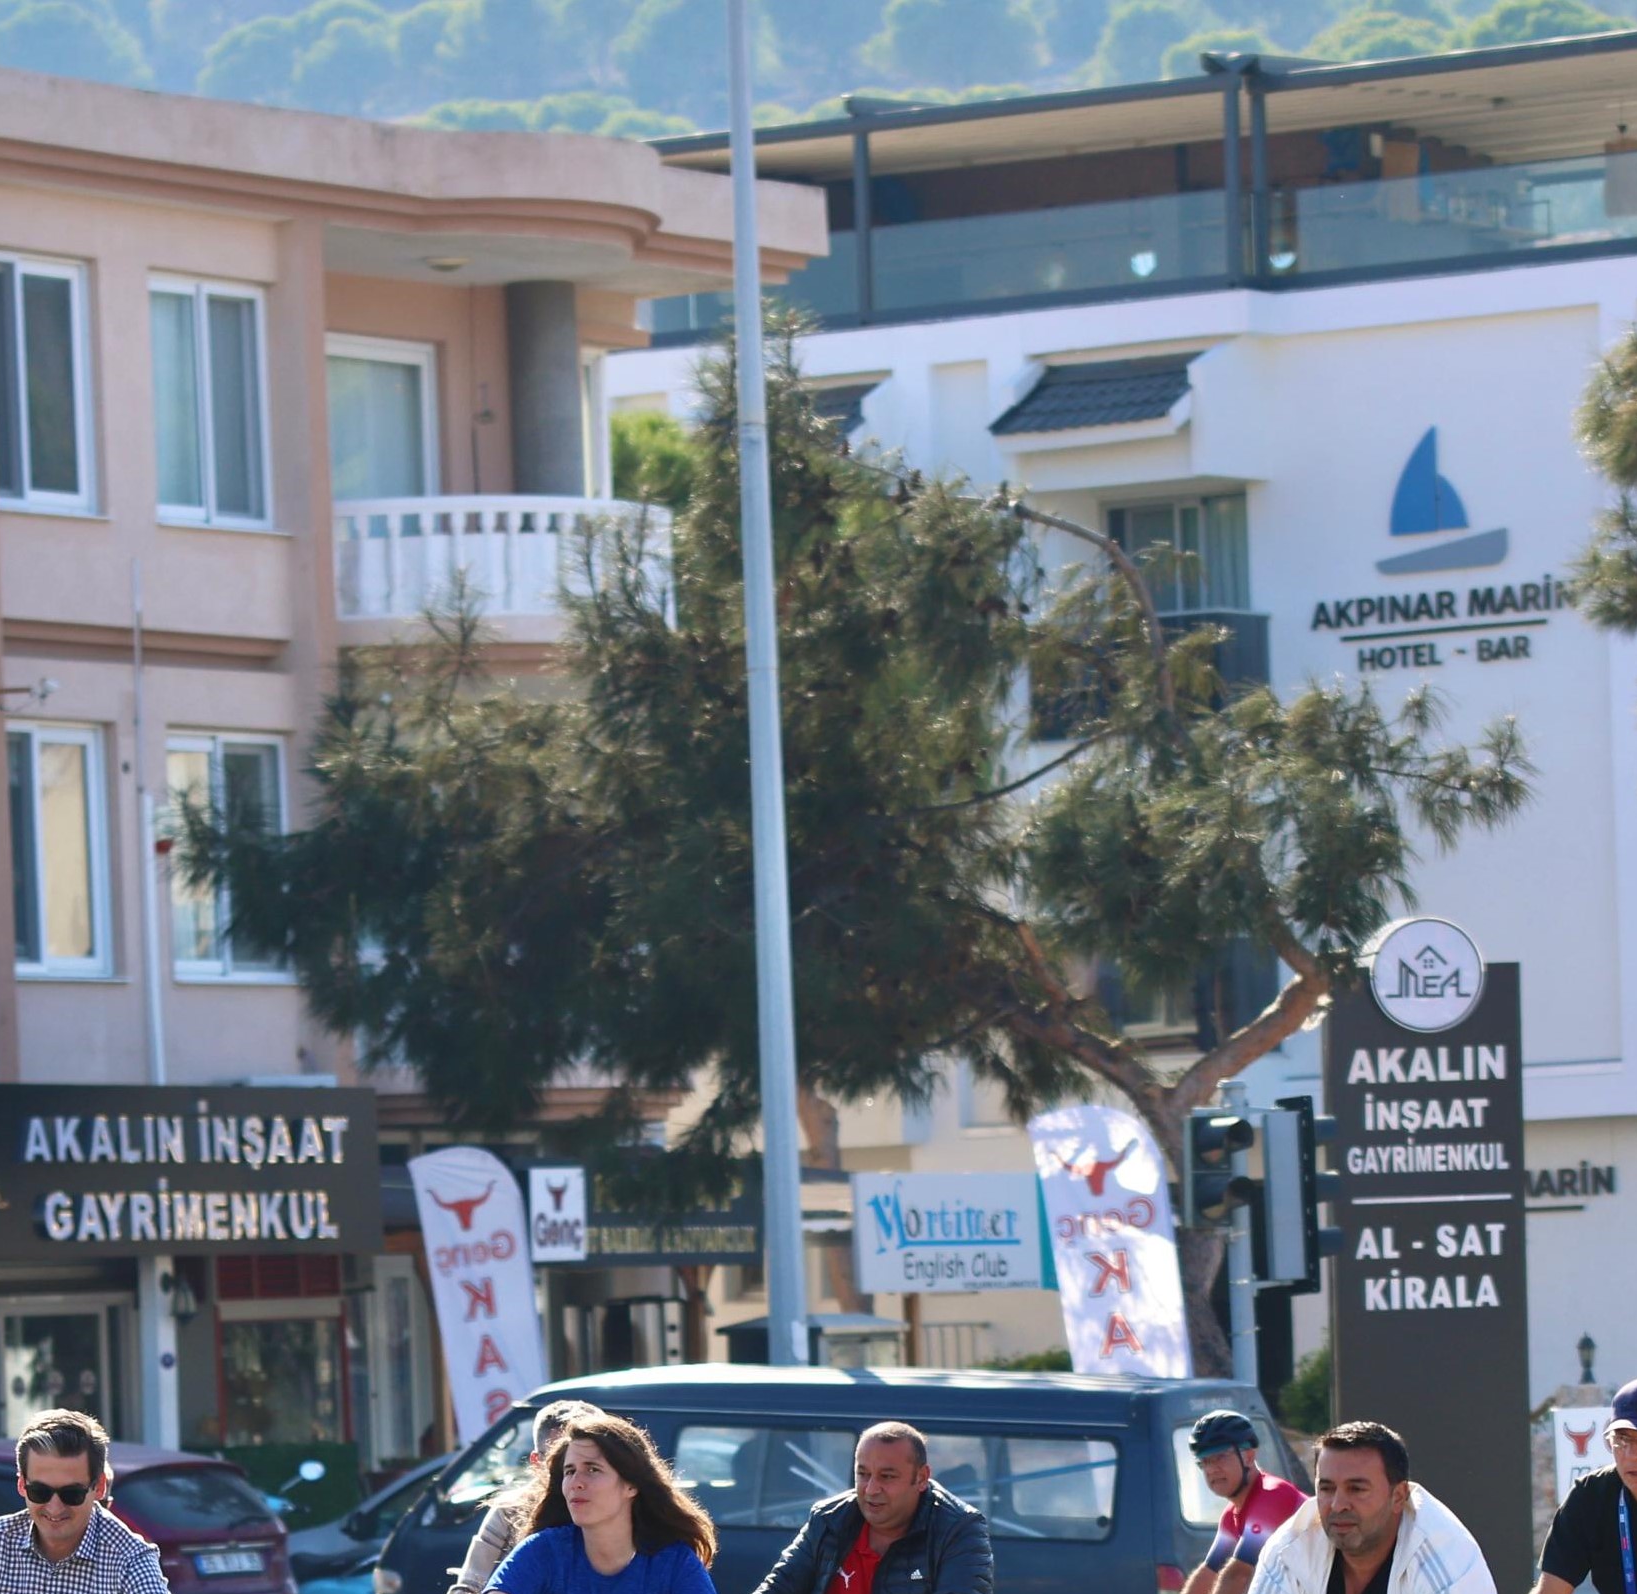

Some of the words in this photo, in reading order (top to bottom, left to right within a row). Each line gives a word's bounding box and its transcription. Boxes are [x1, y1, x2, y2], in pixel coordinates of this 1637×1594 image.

[1311, 587, 1457, 631] AKPINAR
[1357, 643, 1442, 672] HOTEL
[1477, 636, 1531, 663] BAR
[1348, 1045, 1506, 1085] AKALIN
[1364, 1093, 1489, 1134] İNŞAAT
[24, 1114, 186, 1164] AKALIN
[197, 1100, 349, 1170] İNŞAAT
[1347, 1137, 1510, 1175] GAYRİMENKUL
[44, 1177, 340, 1242] GAYRİMENKUL
[867, 1179, 1021, 1255] Mortimer
[535, 1213, 583, 1250] Genç
[1355, 1227, 1399, 1260] AL
[1436, 1224, 1505, 1259] SAT
[903, 1252, 965, 1288] English
[971, 1252, 1009, 1278] Club
[1365, 1269, 1499, 1311] KİRALA
